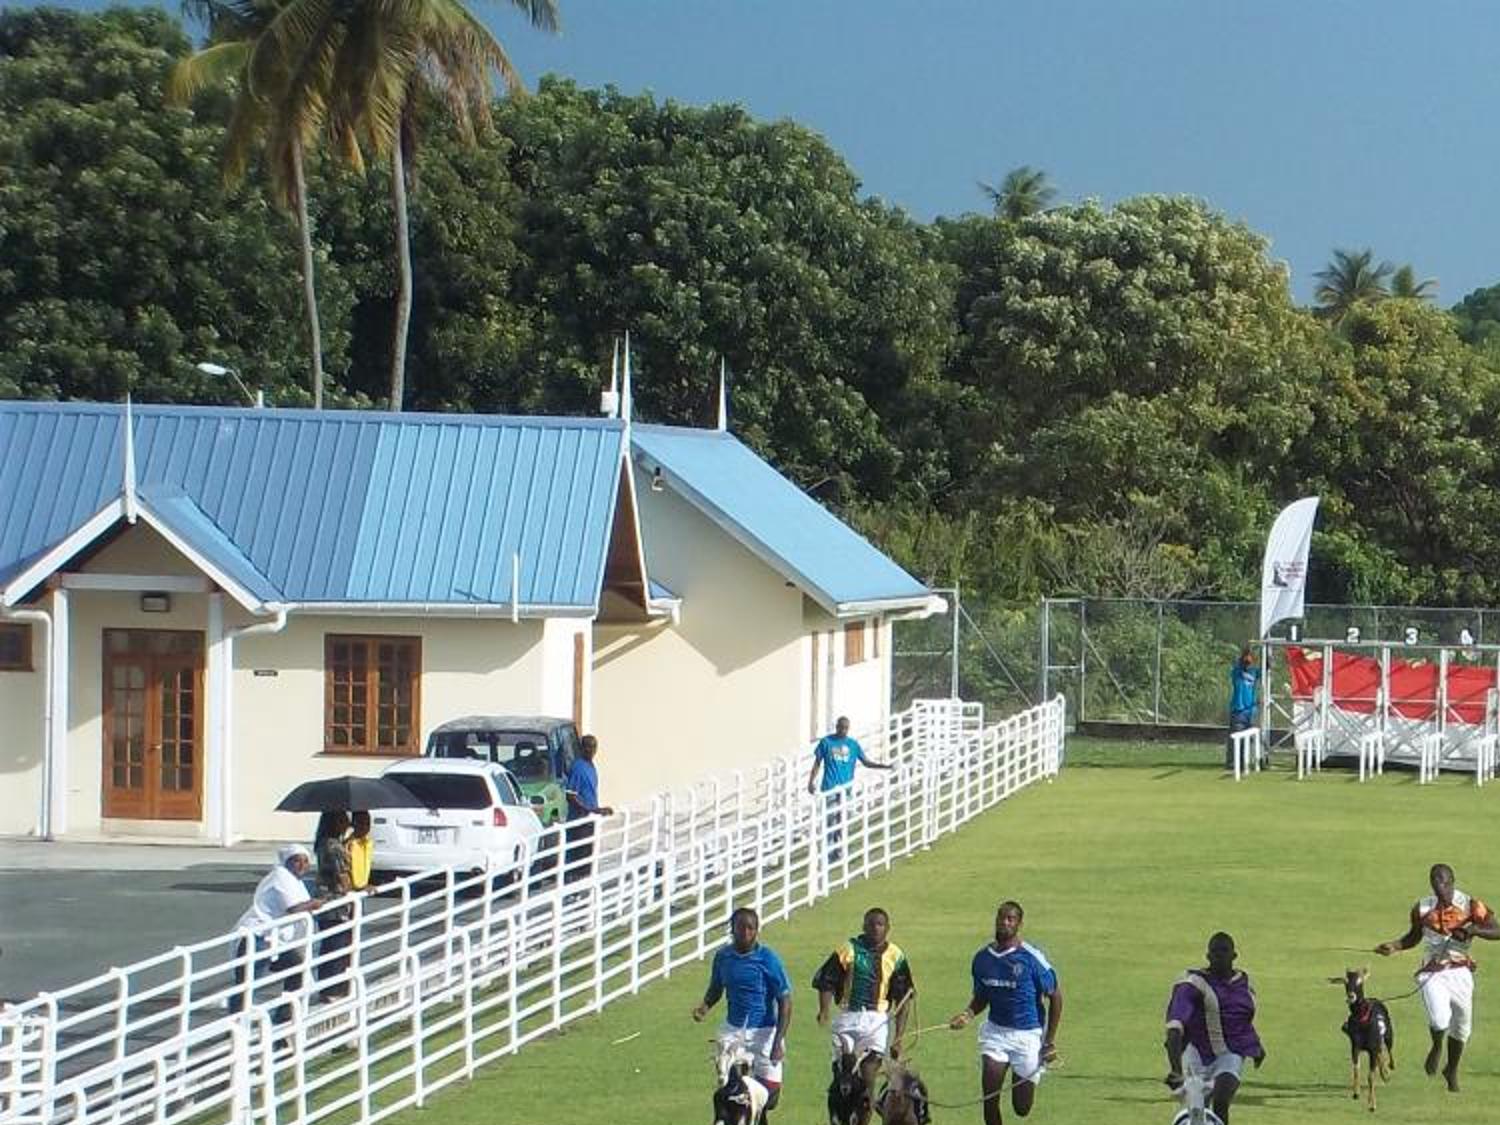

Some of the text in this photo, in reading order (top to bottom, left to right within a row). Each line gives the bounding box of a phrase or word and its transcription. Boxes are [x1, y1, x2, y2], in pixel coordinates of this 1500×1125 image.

[1347, 627, 1360, 643] 2
[1405, 627, 1418, 645] 3
[1461, 629, 1474, 645] 4
